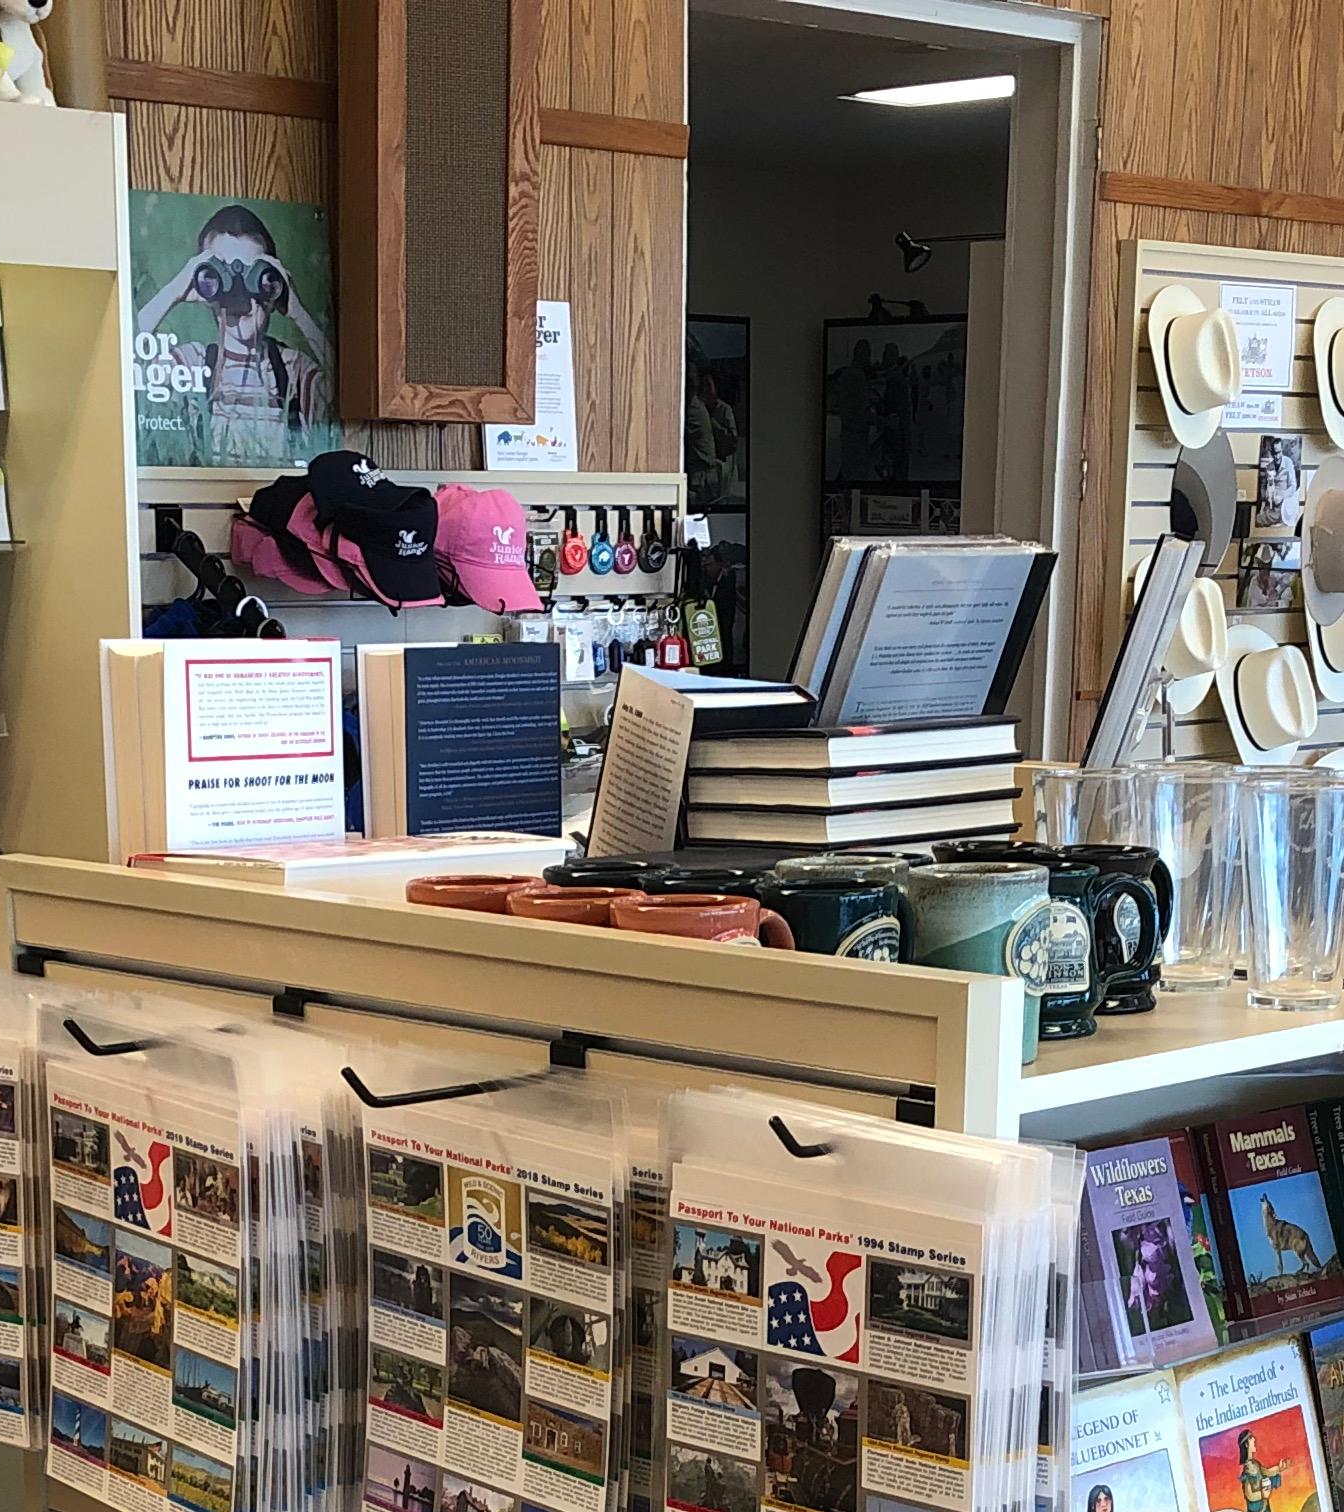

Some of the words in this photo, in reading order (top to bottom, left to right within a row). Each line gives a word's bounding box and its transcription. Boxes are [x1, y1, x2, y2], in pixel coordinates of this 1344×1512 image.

[133, 365, 211, 402] nger
[138, 415, 185, 430] Protect.
[188, 776, 220, 790] PRAISE
[224, 776, 240, 788] FOR
[244, 775, 271, 788] SHOOT
[275, 774, 291, 786] FOR
[294, 773, 309, 785] THE
[312, 773, 334, 784] MOON
[1229, 1122, 1296, 1155] Mammals
[1090, 1156, 1168, 1187] Wildflowers
[1247, 1148, 1286, 1172] Texas
[1115, 1184, 1154, 1208] Texas
[678, 1202, 723, 1221] Passport
[727, 1211, 738, 1223] To
[742, 1214, 766, 1228] Your
[769, 1219, 815, 1238] National
[857, 1236, 884, 1251] 1994
[888, 1241, 925, 1260] Stamp
[929, 1249, 966, 1266] Series
[1208, 1382, 1230, 1400] The
[1230, 1369, 1267, 1396] Legend
[1267, 1364, 1277, 1382] of
[1196, 1412, 1214, 1432] the
[1215, 1402, 1248, 1424] Indian
[1248, 1383, 1298, 1415] Paintbrush
